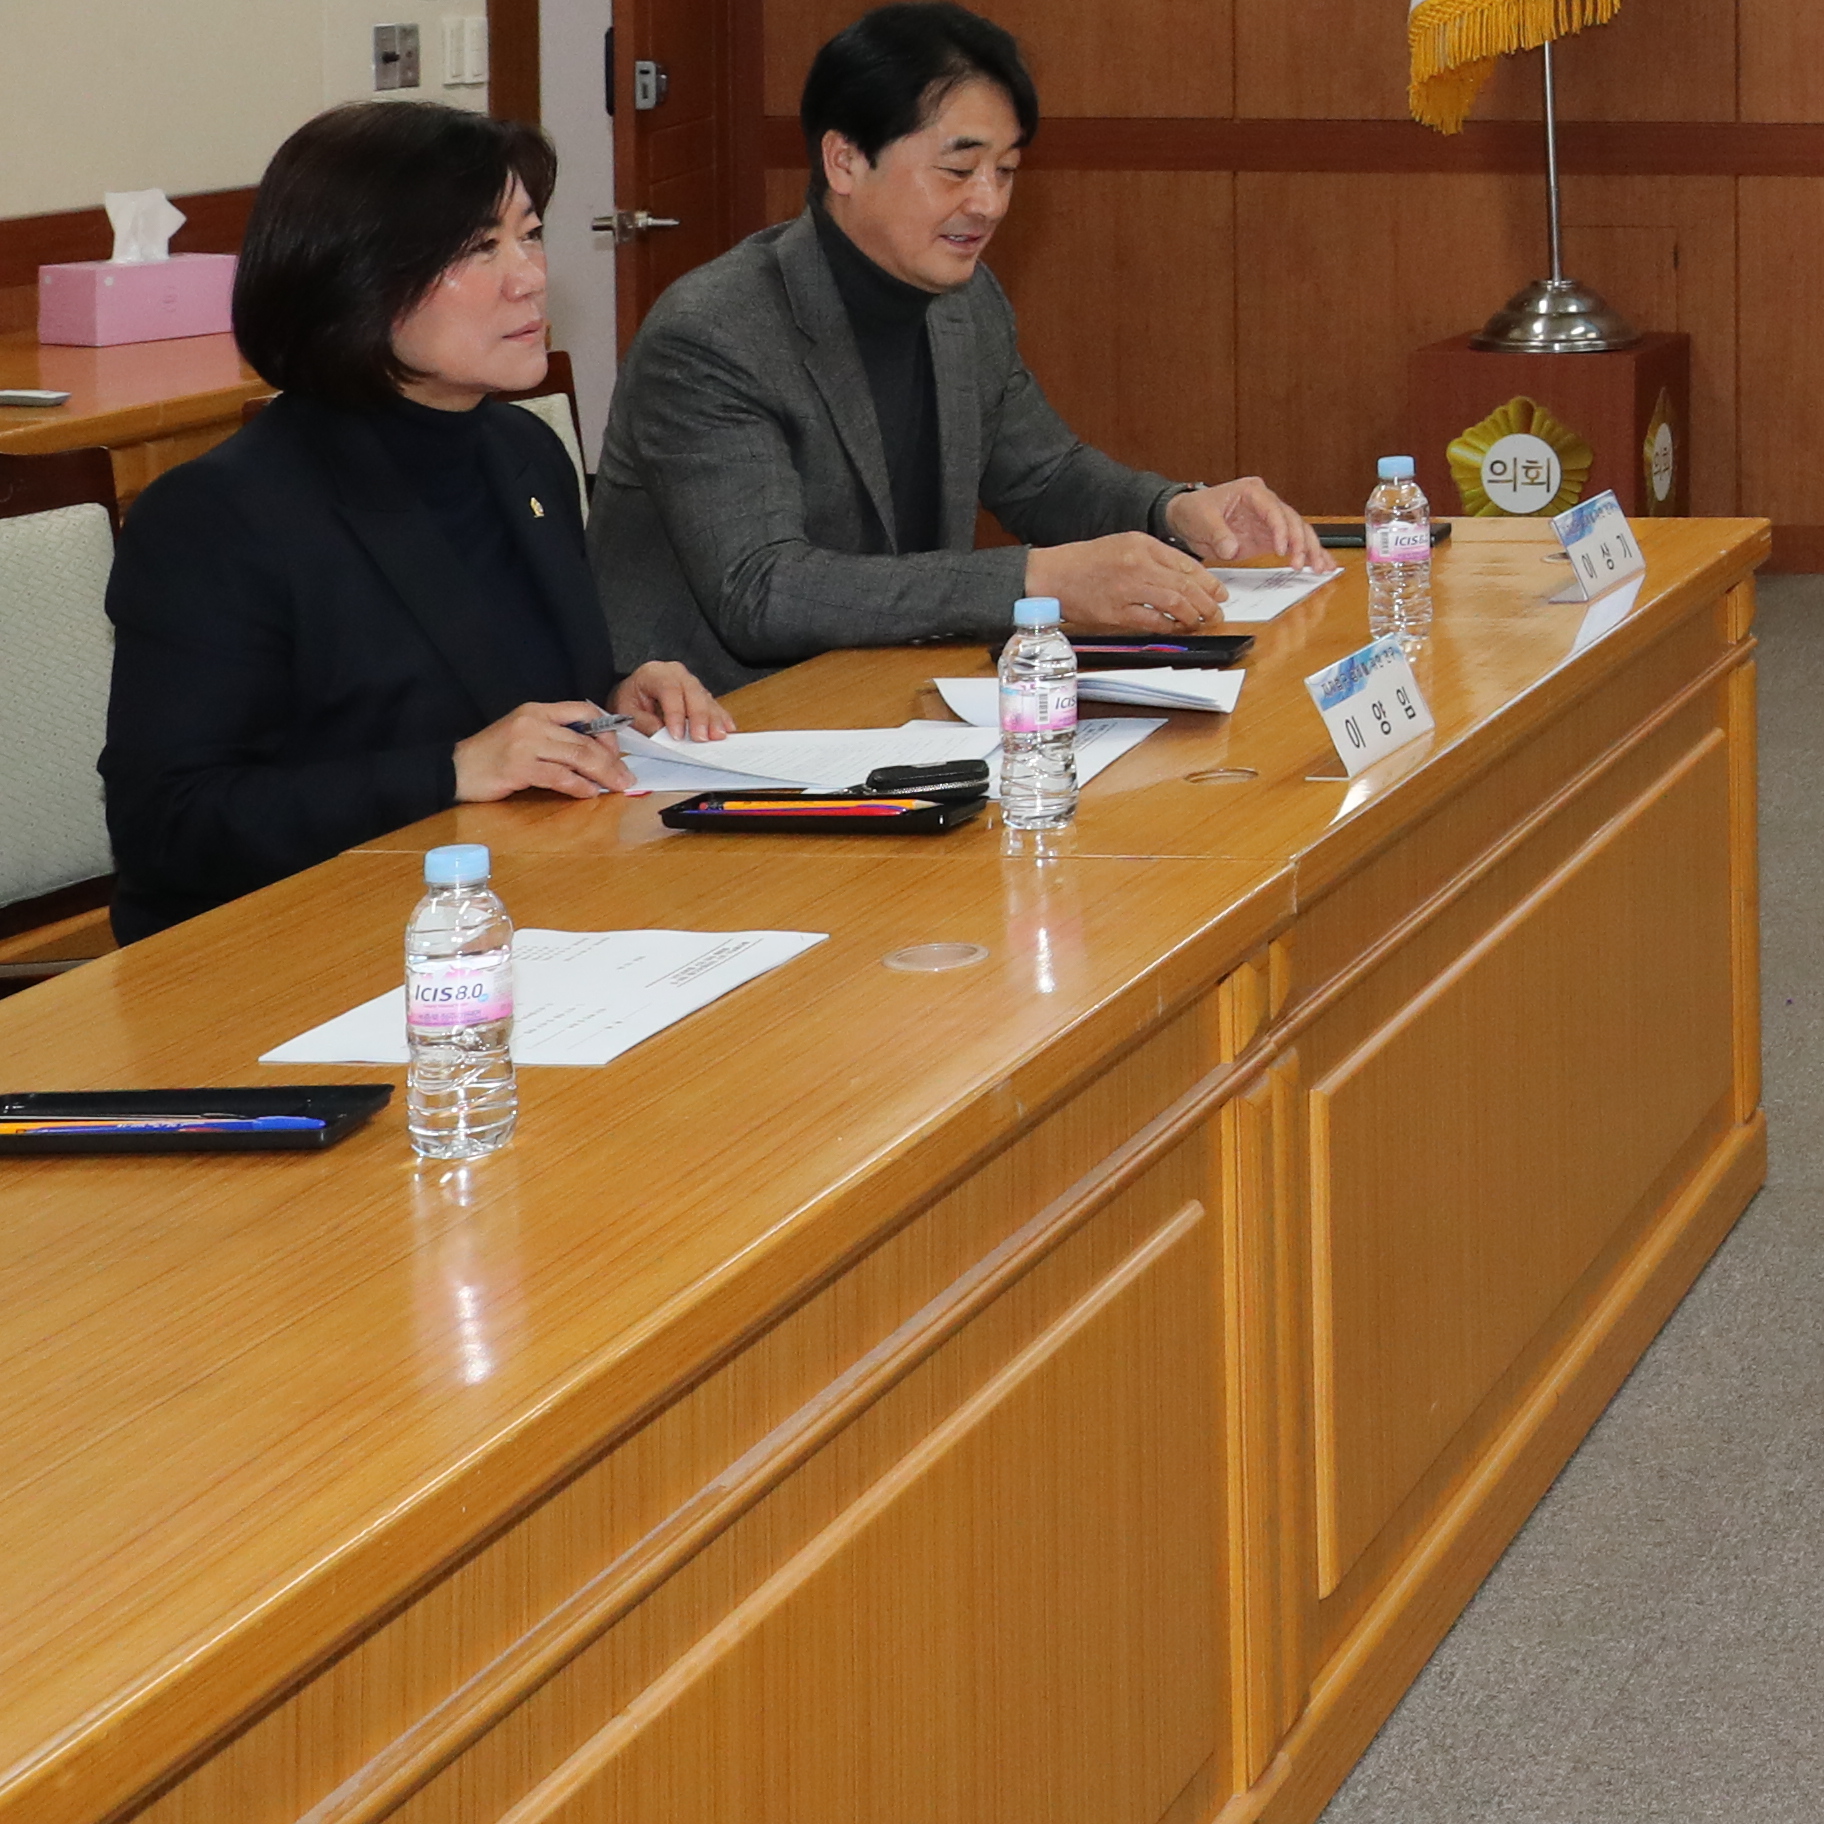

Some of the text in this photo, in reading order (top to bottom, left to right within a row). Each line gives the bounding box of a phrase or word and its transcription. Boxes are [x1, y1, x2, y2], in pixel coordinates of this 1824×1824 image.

[1487, 456, 1552, 494] 의회
[1394, 534, 1418, 547] ICIS
[415, 984, 454, 1002] ICIS
